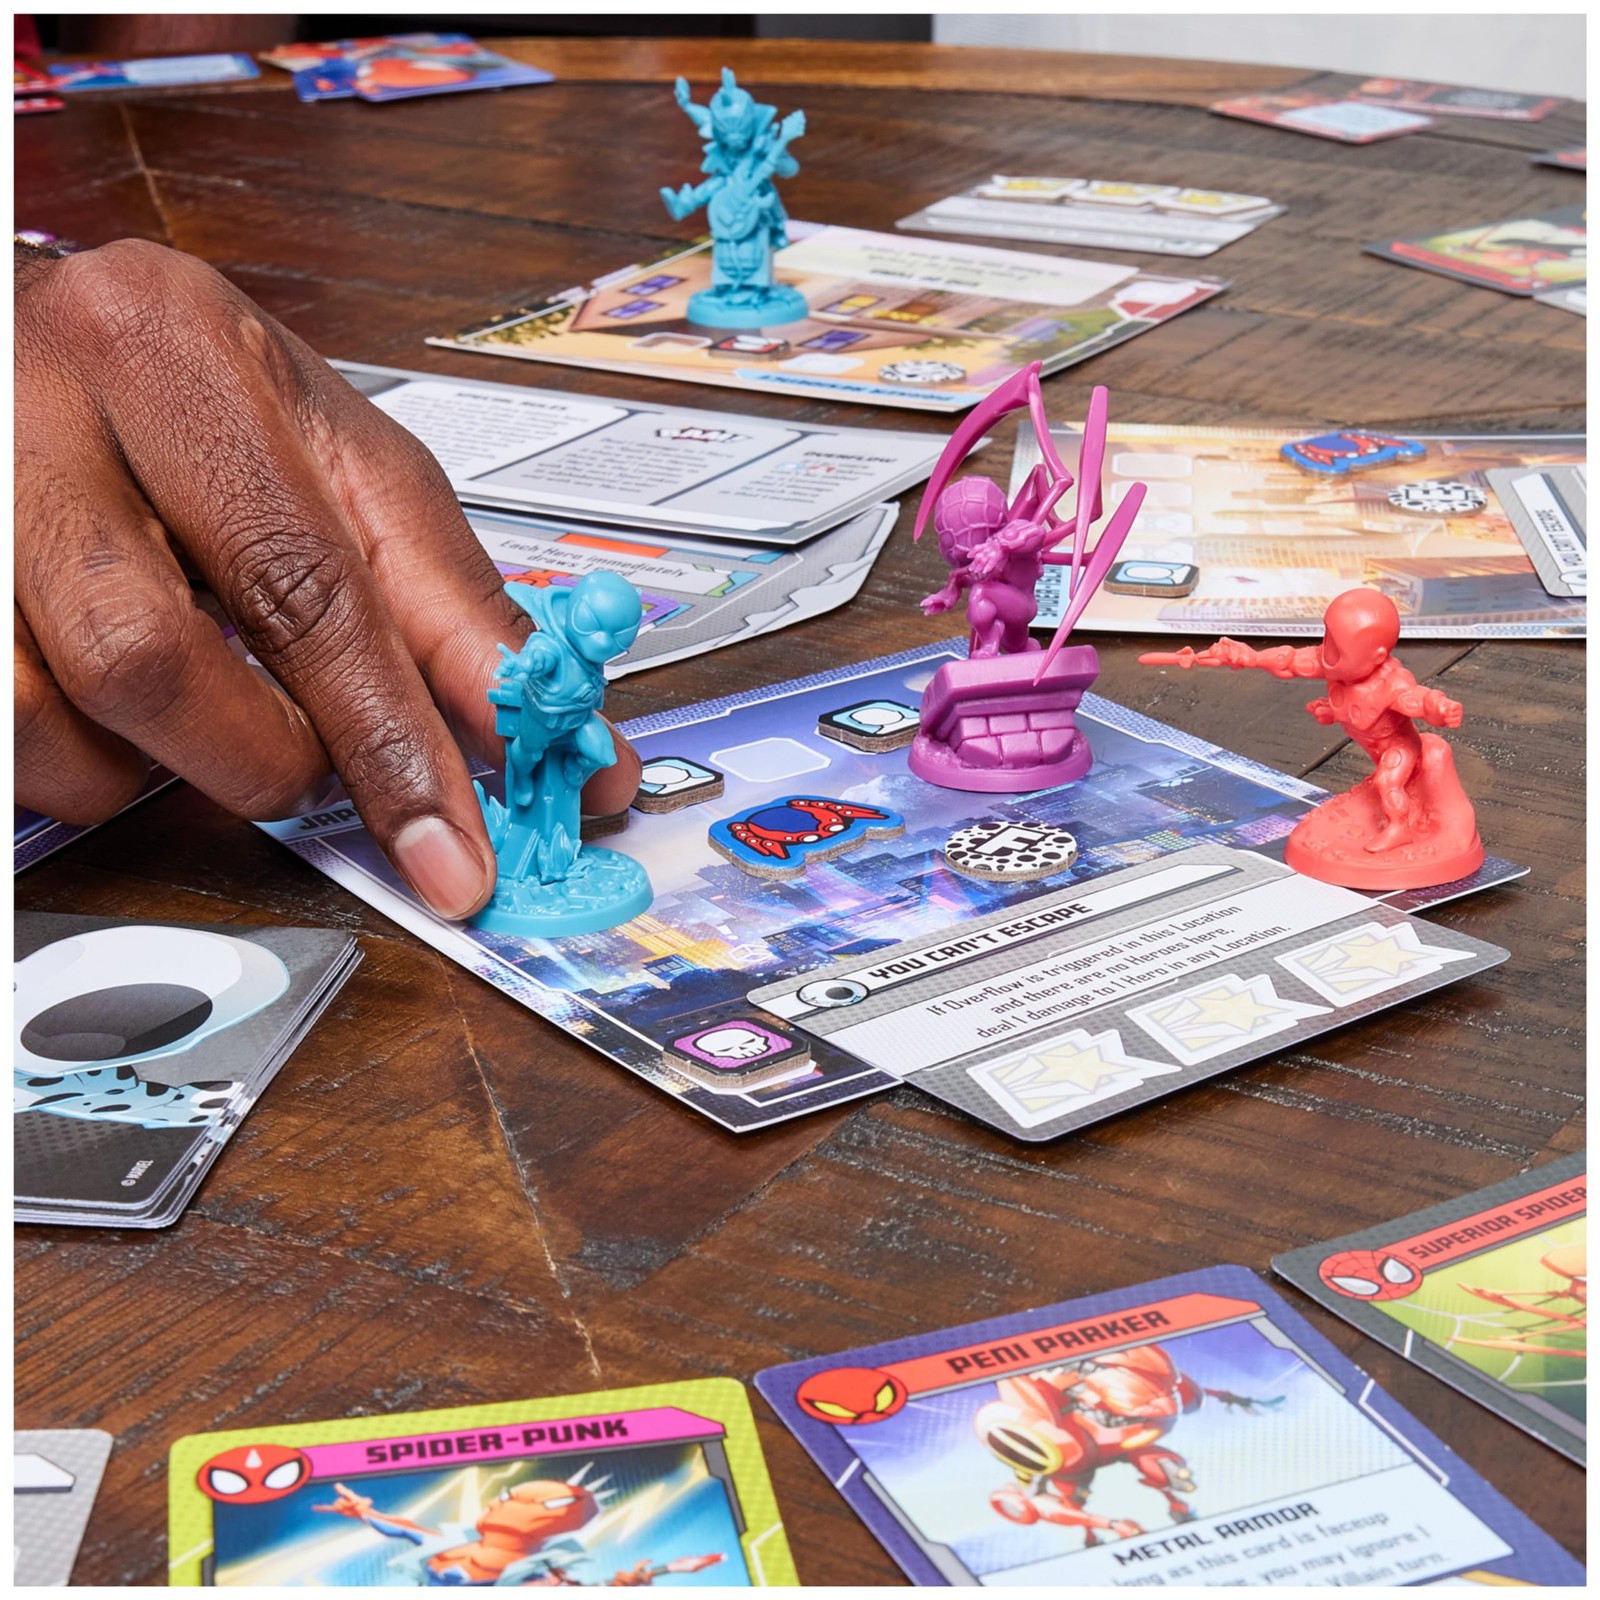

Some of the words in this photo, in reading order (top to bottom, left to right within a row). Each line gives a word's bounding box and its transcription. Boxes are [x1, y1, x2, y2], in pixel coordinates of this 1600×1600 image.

[499, 539, 538, 553] Each
[547, 548, 582, 561] Hero
[587, 555, 690, 578] immediately
[526, 553, 577, 569] draws
[298, 808, 358, 831] JAP
[868, 957, 928, 980] YOU
[923, 933, 1000, 962] CAN'T
[997, 903, 1093, 938] ESCAPE
[926, 1003, 948, 1017] If
[943, 980, 1025, 1010] Overflow
[1021, 975, 1045, 984] is
[1041, 944, 1125, 978] triggered
[1120, 938, 1143, 950] in
[1138, 927, 1176, 943] this
[1169, 905, 1244, 932] Location
[990, 997, 1026, 1015] and
[1022, 982, 1075, 1003] there
[1073, 970, 1107, 986] are
[1105, 961, 1130, 974] no
[1125, 942, 1190, 967] Heroes
[1183, 927, 1236, 945] here,
[976, 1019, 1016, 1039] deal
[1026, 992, 1095, 1021] damage
[1092, 985, 1118, 998] to
[1120, 967, 1169, 986] Hero
[1168, 960, 1189, 972] in
[1186, 949, 1221, 965] any
[1213, 925, 1292, 953] Location.
[1407, 1215, 1519, 1260] SUPERIOR
[945, 1342, 1031, 1375] PENI
[1030, 1310, 1172, 1354] PARKER
[365, 1418, 629, 1465] SPIDER-PUNK
[1112, 1531, 1214, 1566] METAL
[1214, 1501, 1321, 1540] ARMOR
[1167, 1563, 1194, 1579] as
[1195, 1550, 1239, 1572] this
[1242, 1534, 1292, 1561] card
[1291, 1529, 1316, 1545] is
[1314, 1511, 1390, 1540] faceup
[1259, 1566, 1298, 1585] you
[1300, 1552, 1347, 1572] may
[1347, 1531, 1418, 1559] ignore
[1324, 1564, 1394, 1586] Villain
